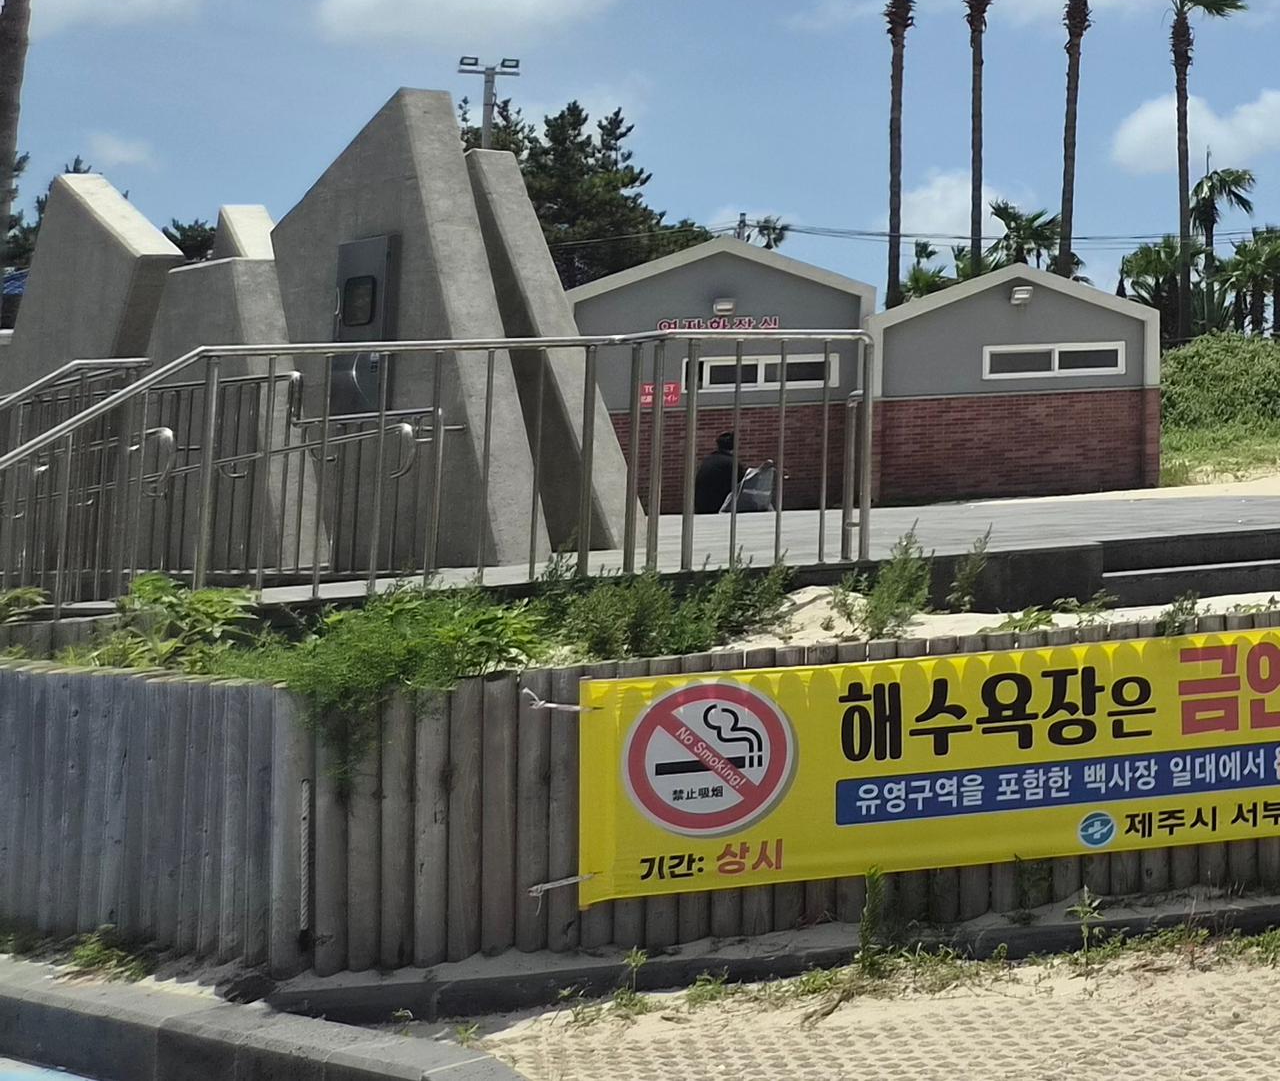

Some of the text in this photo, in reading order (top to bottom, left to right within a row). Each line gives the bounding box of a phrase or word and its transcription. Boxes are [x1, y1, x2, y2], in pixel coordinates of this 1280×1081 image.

[838, 666, 1157, 762] 해수욕장은
[675, 726, 747, 789] No Smoking!
[856, 773, 985, 816] 유영구역을
[996, 766, 1072, 801] 포함한
[1083, 759, 1158, 794] 백사장
[1169, 748, 1266, 788] 일대에서
[672, 786, 724, 802] 禁止吸烟
[1124, 806, 1218, 838] 제주시
[640, 838, 784, 880] 기간: 상시
